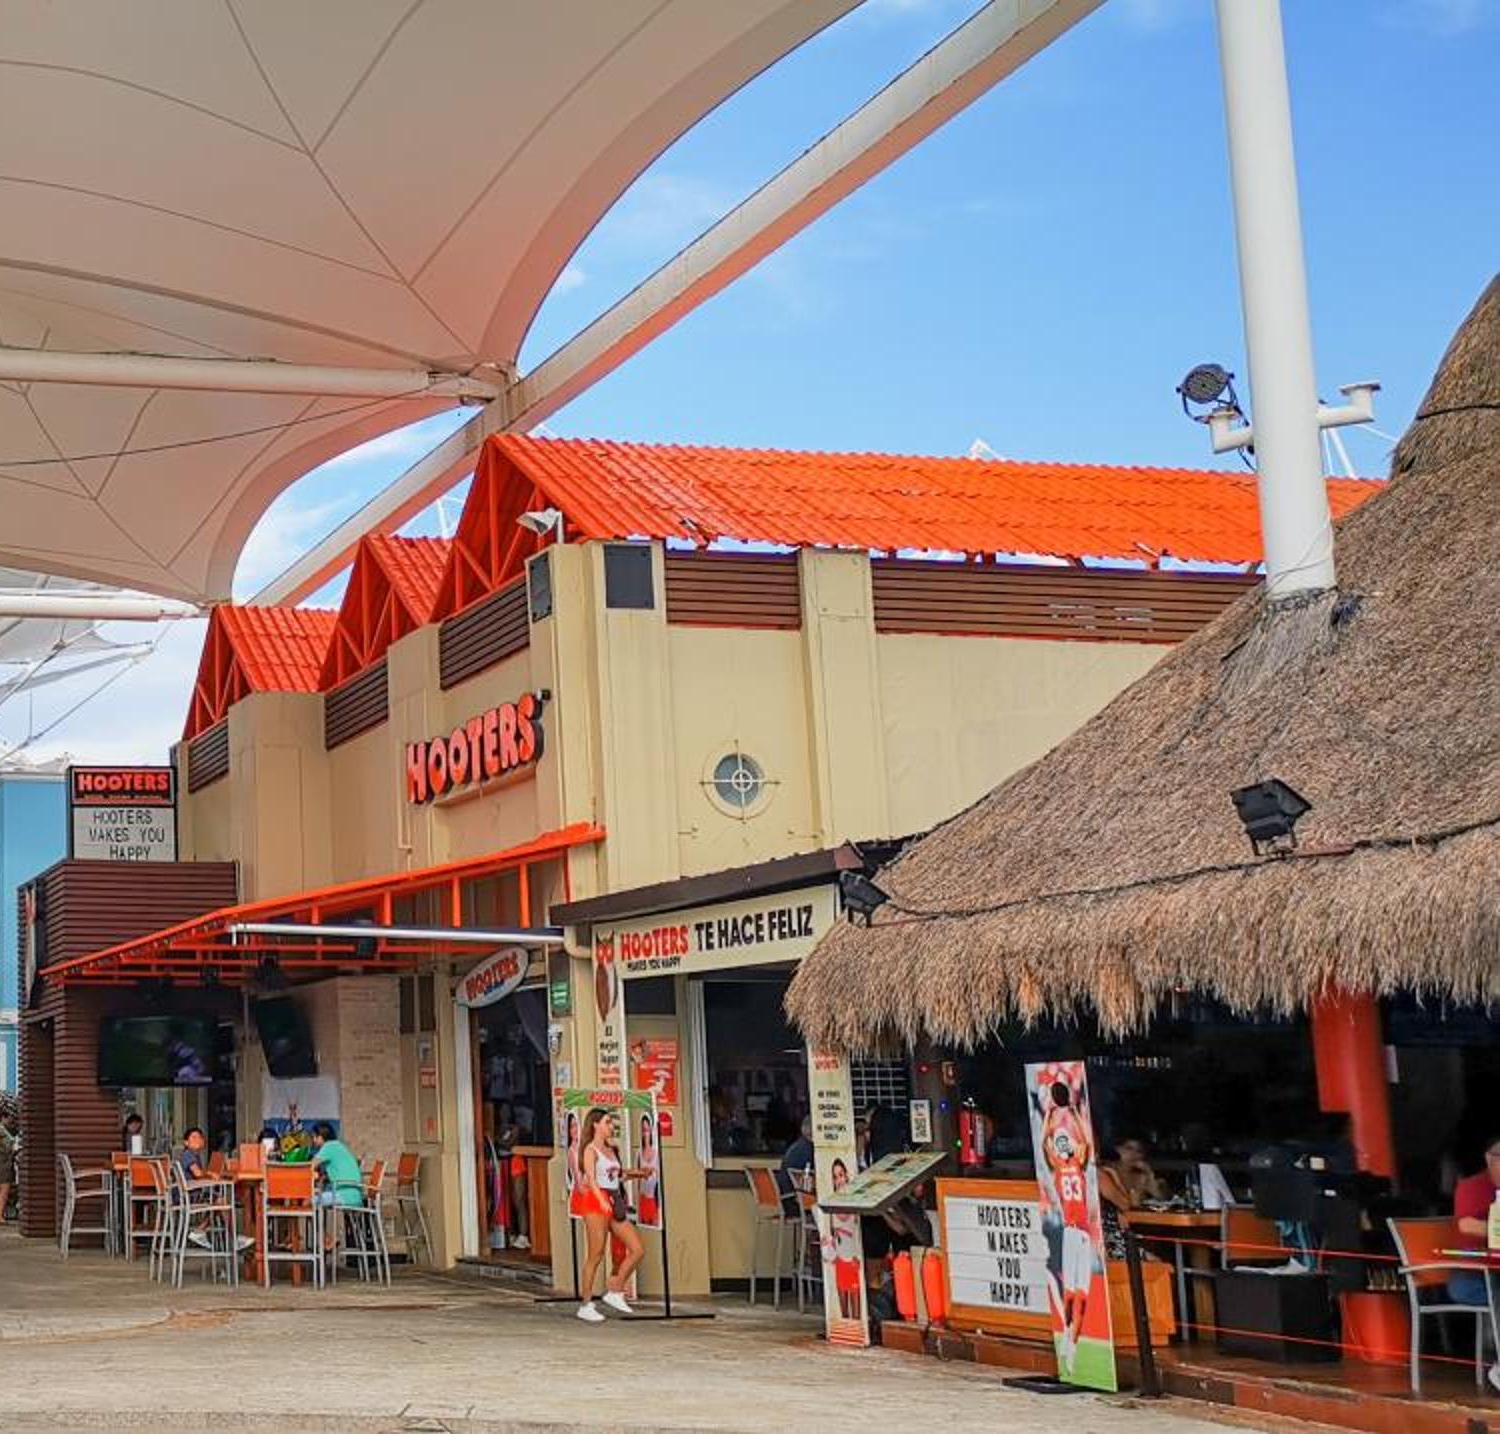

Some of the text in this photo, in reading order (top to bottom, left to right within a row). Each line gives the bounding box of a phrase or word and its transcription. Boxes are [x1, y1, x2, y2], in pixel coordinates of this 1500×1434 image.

[407, 693, 536, 803] HOOTERS
[77, 773, 169, 792] HOOTERS
[93, 809, 154, 824] HOOTERS
[140, 828, 165, 843] YOU
[109, 845, 151, 861] HAPPY
[621, 904, 814, 961] HOOTERS TE HACE FELIZ
[1061, 1175, 1083, 1201] 83
[978, 1205, 1031, 1229] HOOTERS
[987, 1232, 1028, 1254] MAKES
[997, 1257, 1021, 1279] YOU
[990, 1282, 1029, 1306] HAPPY
